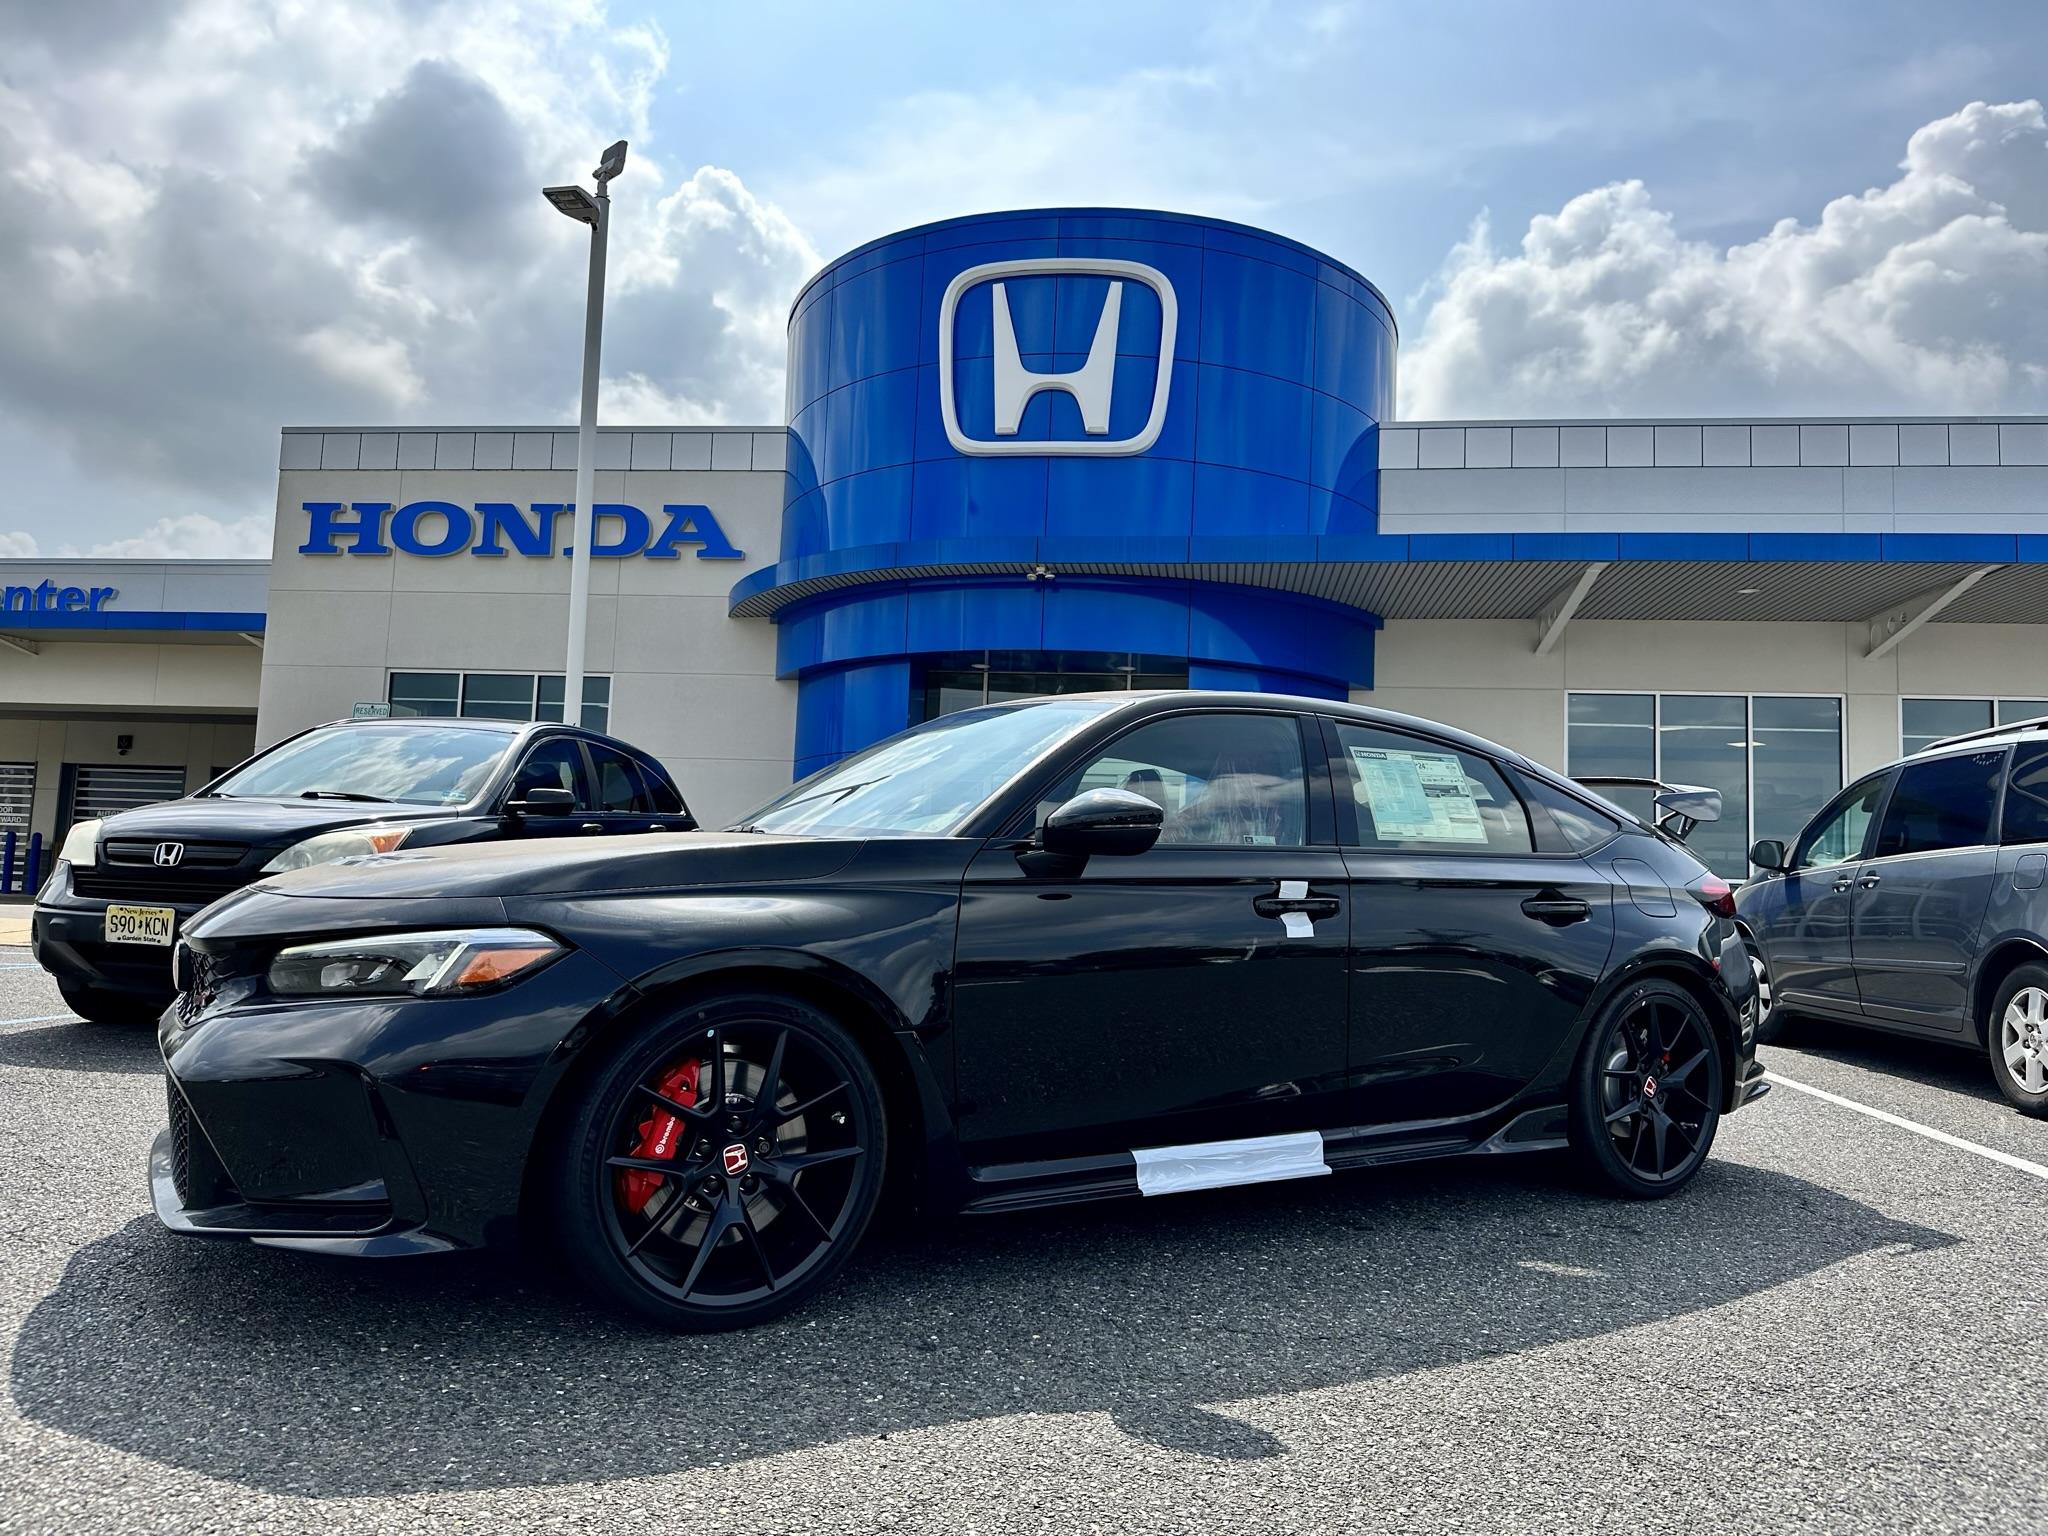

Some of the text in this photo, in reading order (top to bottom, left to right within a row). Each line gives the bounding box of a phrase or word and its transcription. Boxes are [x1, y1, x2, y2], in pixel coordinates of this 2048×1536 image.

[299, 501, 744, 558] HONDA
[0, 578, 115, 611] nter
[355, 707, 388, 716] RESERVED
[139, 908, 158, 916] Jersey
[110, 915, 169, 936] S90 KCN
